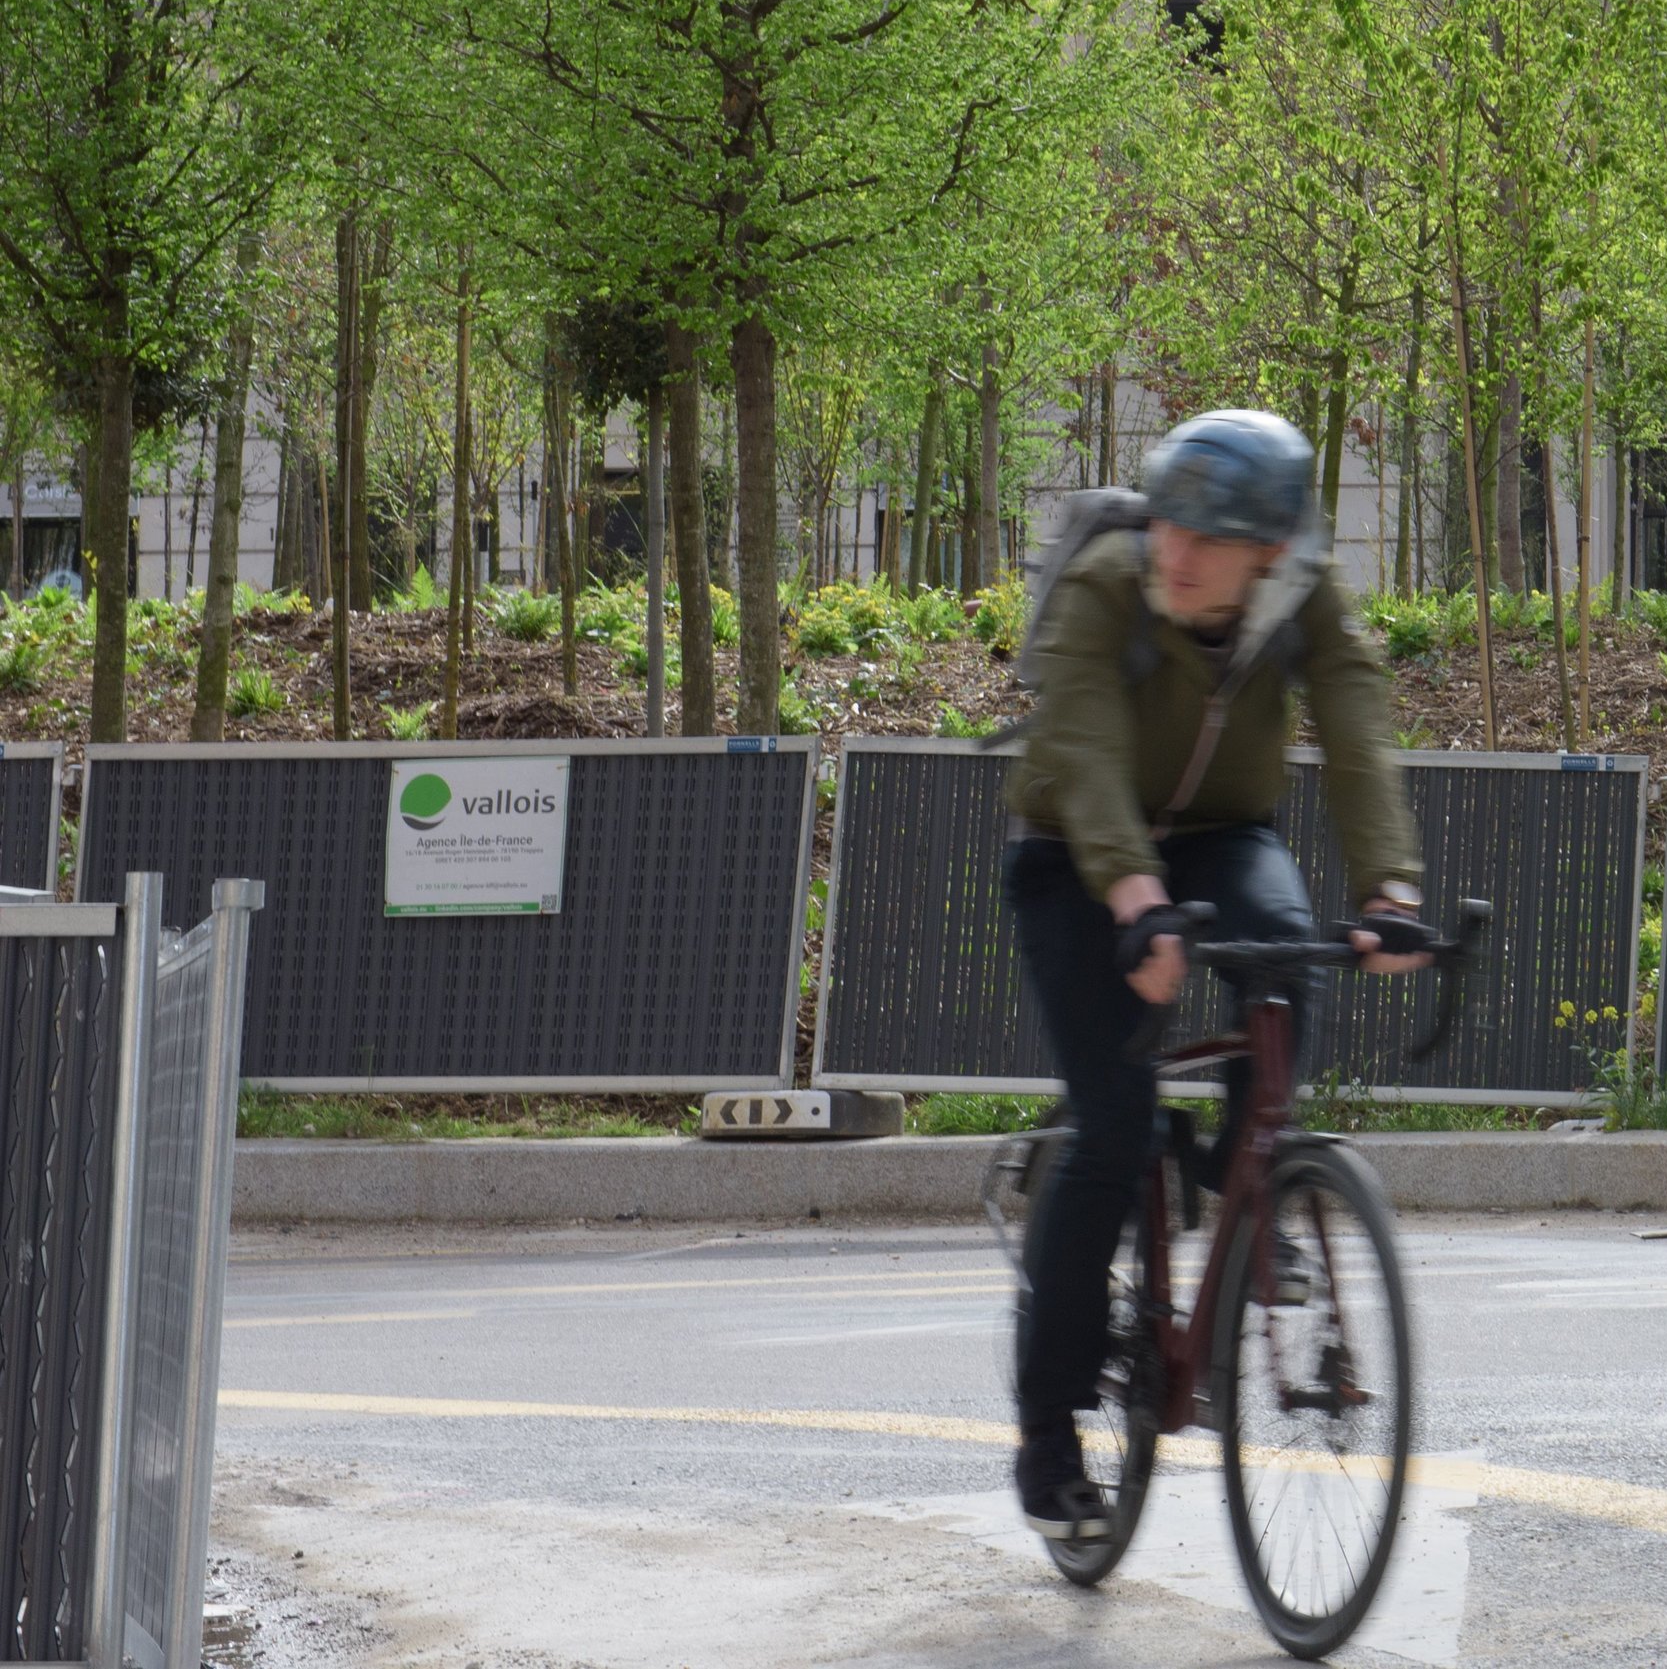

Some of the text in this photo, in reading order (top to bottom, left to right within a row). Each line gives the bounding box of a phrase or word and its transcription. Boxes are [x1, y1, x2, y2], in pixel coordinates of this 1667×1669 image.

[461, 788, 557, 815] vallois
[416, 833, 534, 849] Agence Île-de-France
